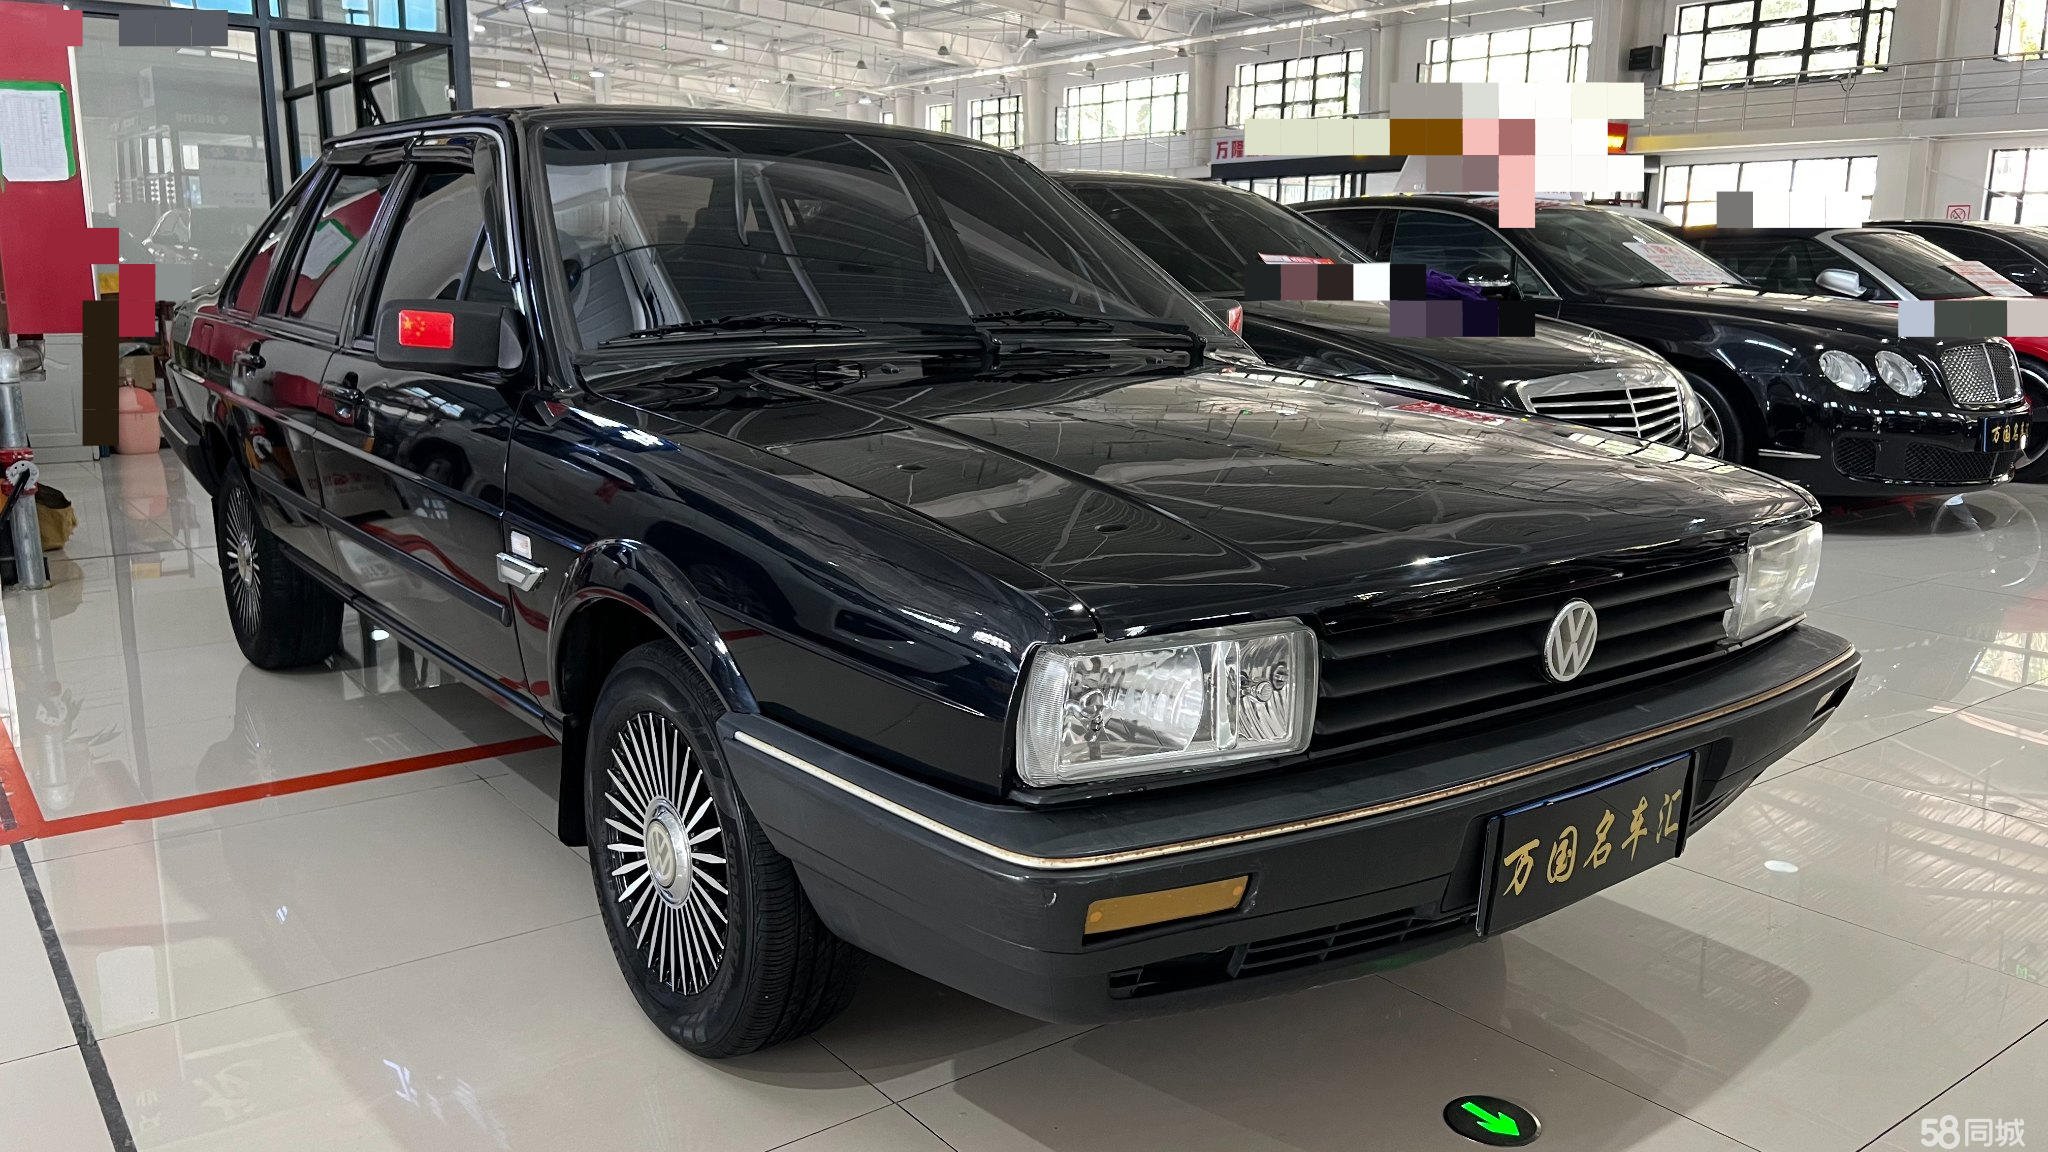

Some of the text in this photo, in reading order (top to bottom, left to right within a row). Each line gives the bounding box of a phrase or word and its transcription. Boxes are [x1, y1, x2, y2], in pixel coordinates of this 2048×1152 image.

[1547, 604, 1597, 679] VW
[1504, 789, 1681, 896] 万国名车汇
